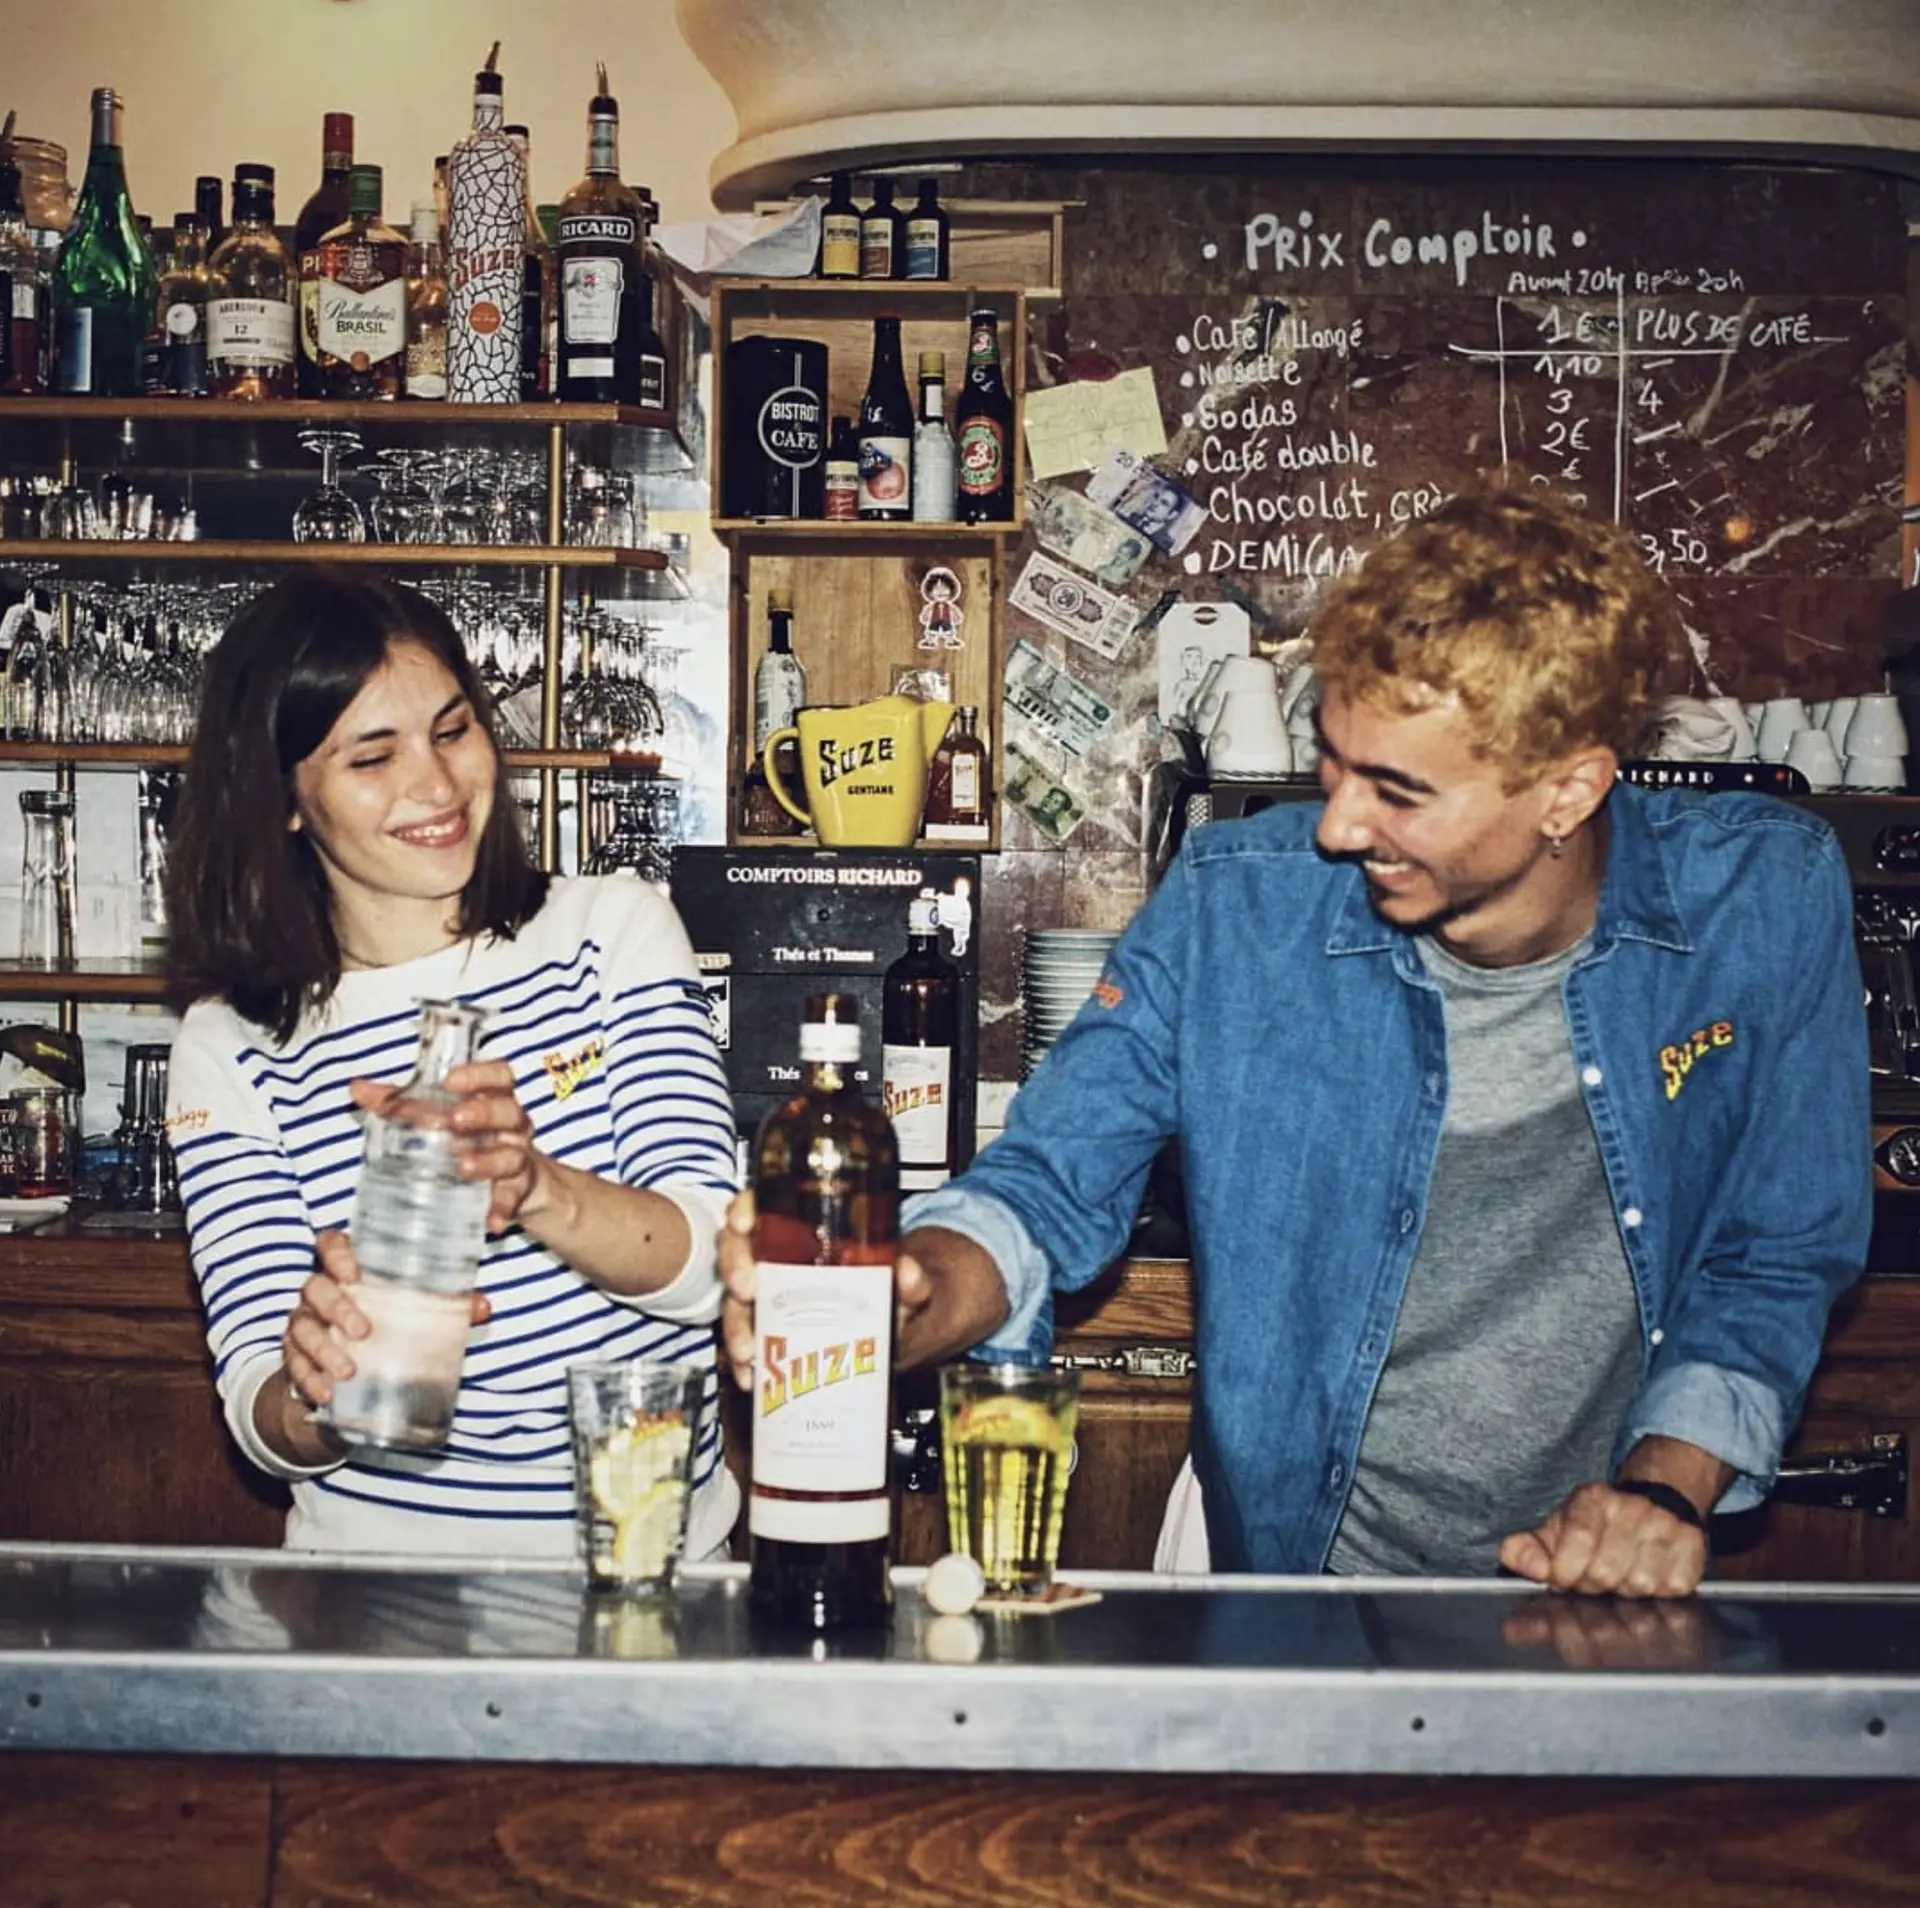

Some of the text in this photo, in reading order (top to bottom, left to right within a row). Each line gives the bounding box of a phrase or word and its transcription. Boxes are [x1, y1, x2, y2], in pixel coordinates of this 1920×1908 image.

[561, 221, 629, 238] RICARD
[454, 246, 516, 292] Suze
[1696, 267, 1745, 294] 20h
[234, 323, 249, 335] 12
[335, 320, 388, 334] BRASIL
[1635, 307, 1701, 347] PLUS
[1703, 314, 1742, 342] DE
[1533, 354, 1602, 385] 1,10
[1199, 393, 1297, 430] Sodas
[1545, 388, 1573, 415] 3
[1637, 378, 1664, 415] 4
[771, 403, 820, 423] BISTROT
[1202, 429, 1377, 482] Café double
[1639, 528, 1709, 574] 3,50
[818, 737, 896, 790] Suze
[847, 784, 895, 796] GENTIANE
[726, 867, 923, 886] COMPTOIRS RICHARD
[772, 947, 804, 962] Thés
[767, 1065, 801, 1081] Thés
[1660, 1020, 1735, 1101] Suze
[884, 1079, 942, 1118] Suze
[761, 1334, 878, 1418] Suze
